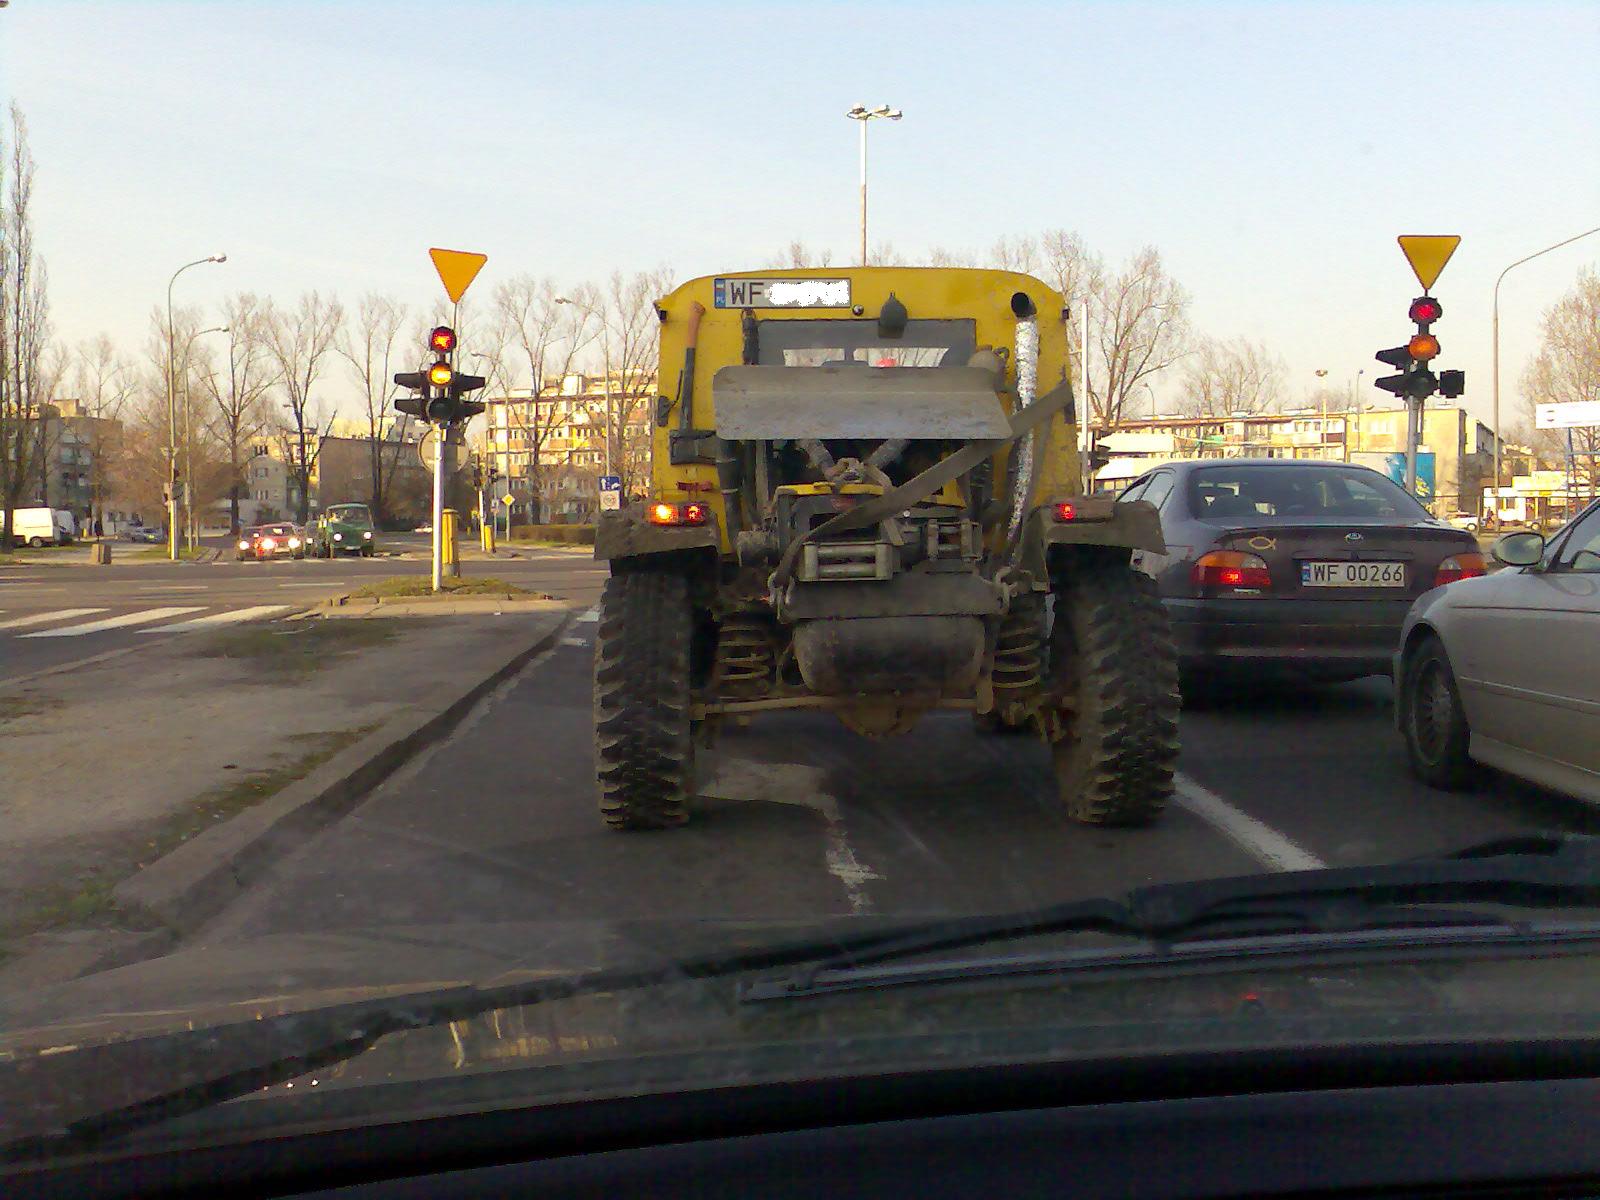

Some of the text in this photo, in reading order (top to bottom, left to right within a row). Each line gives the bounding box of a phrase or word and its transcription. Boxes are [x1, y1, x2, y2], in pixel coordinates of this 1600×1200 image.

[731, 282, 764, 304] WF
[1313, 564, 1402, 582] WF 00266
